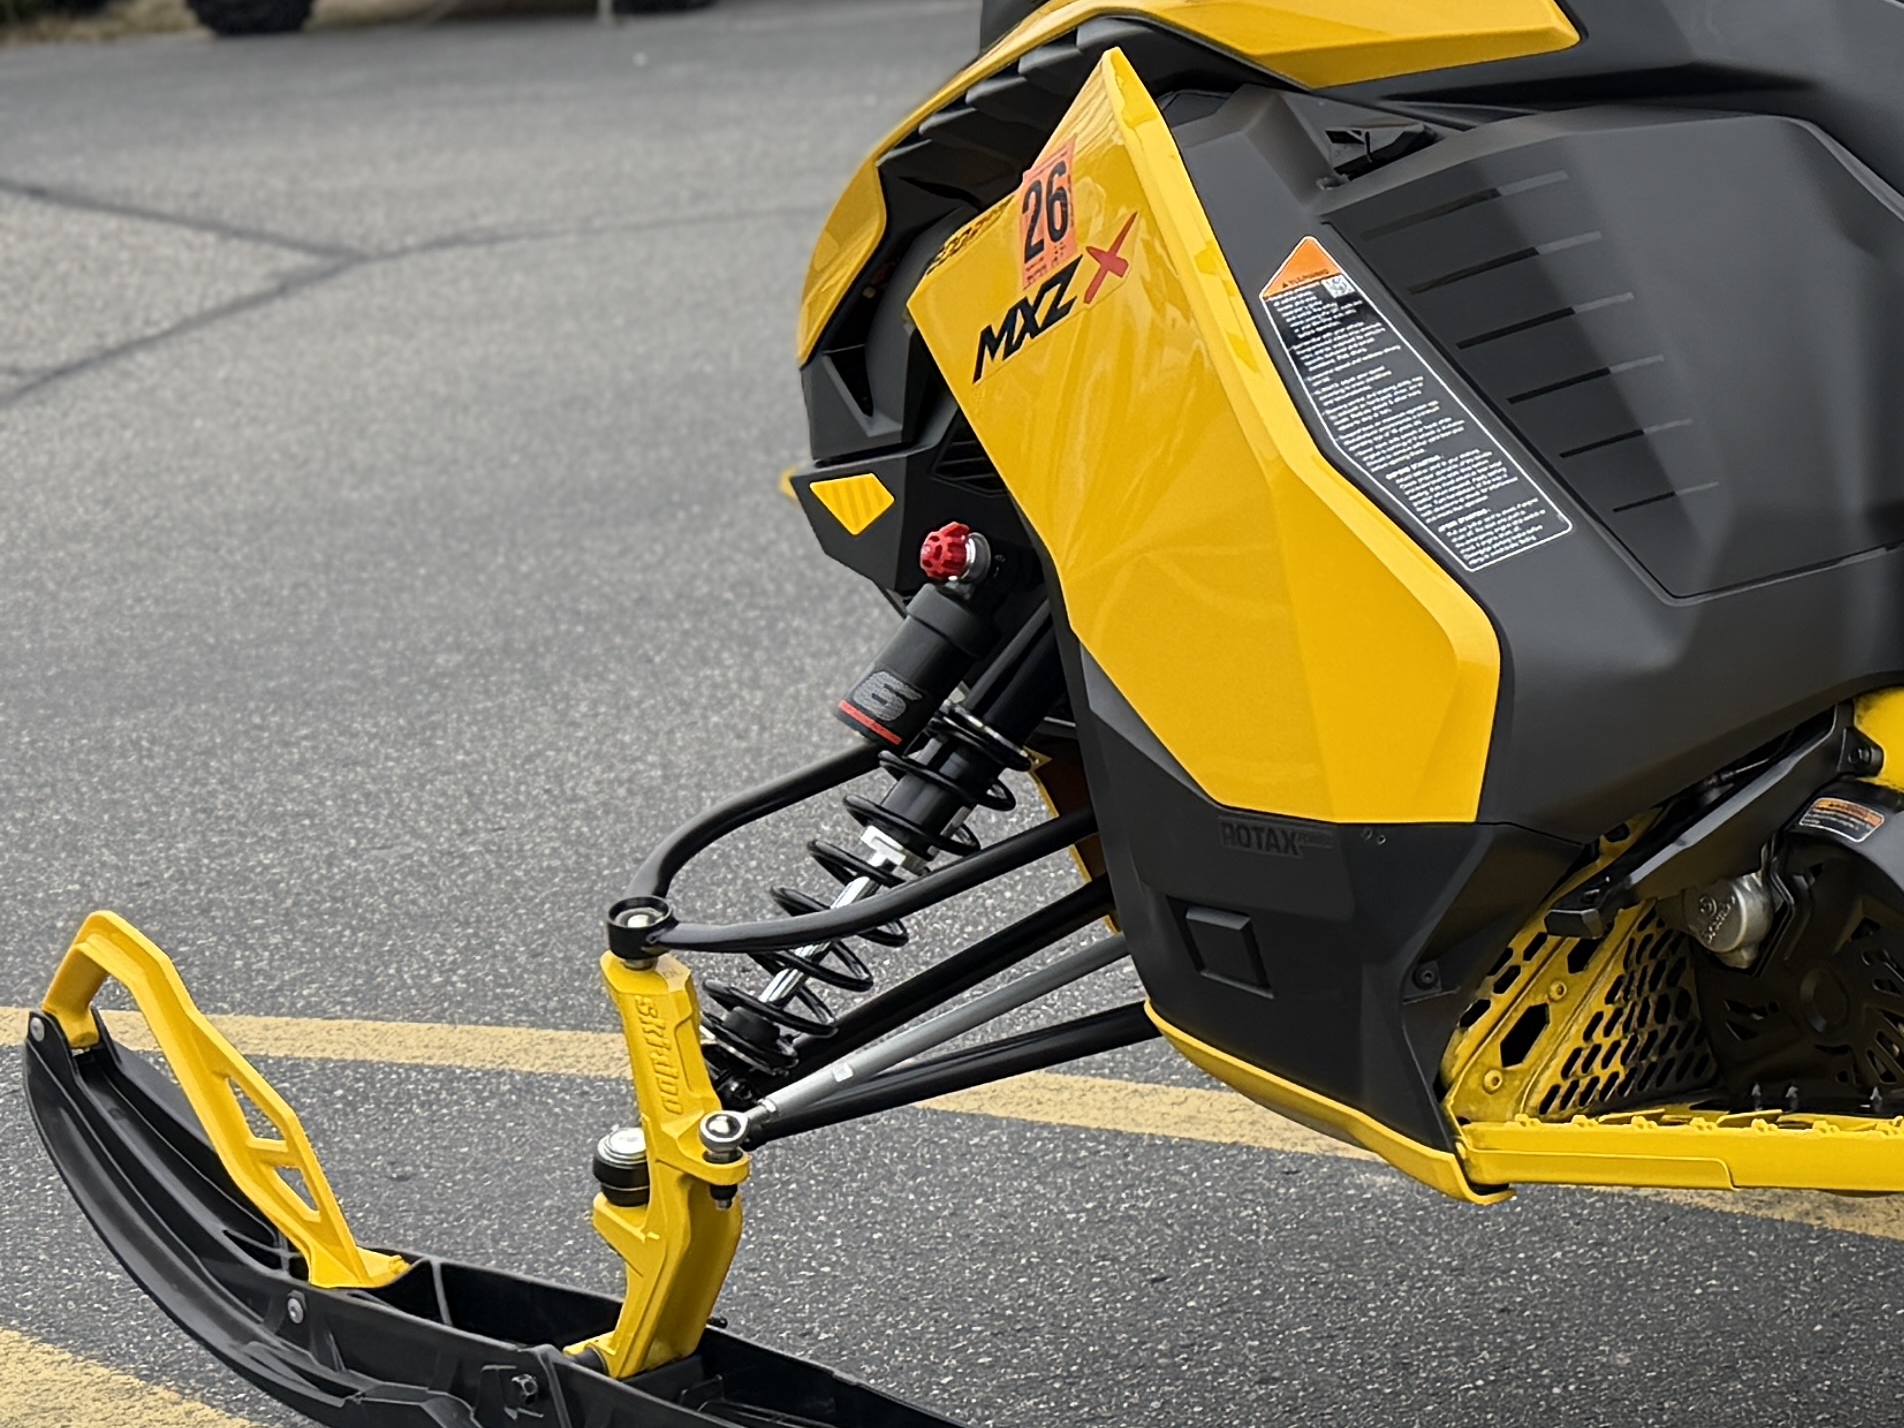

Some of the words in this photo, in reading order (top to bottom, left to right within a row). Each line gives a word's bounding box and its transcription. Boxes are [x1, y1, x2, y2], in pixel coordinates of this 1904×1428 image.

[1022, 160, 1069, 264] 26
[972, 254, 1083, 384] MXZ
[1220, 821, 1300, 857] ROTAX
